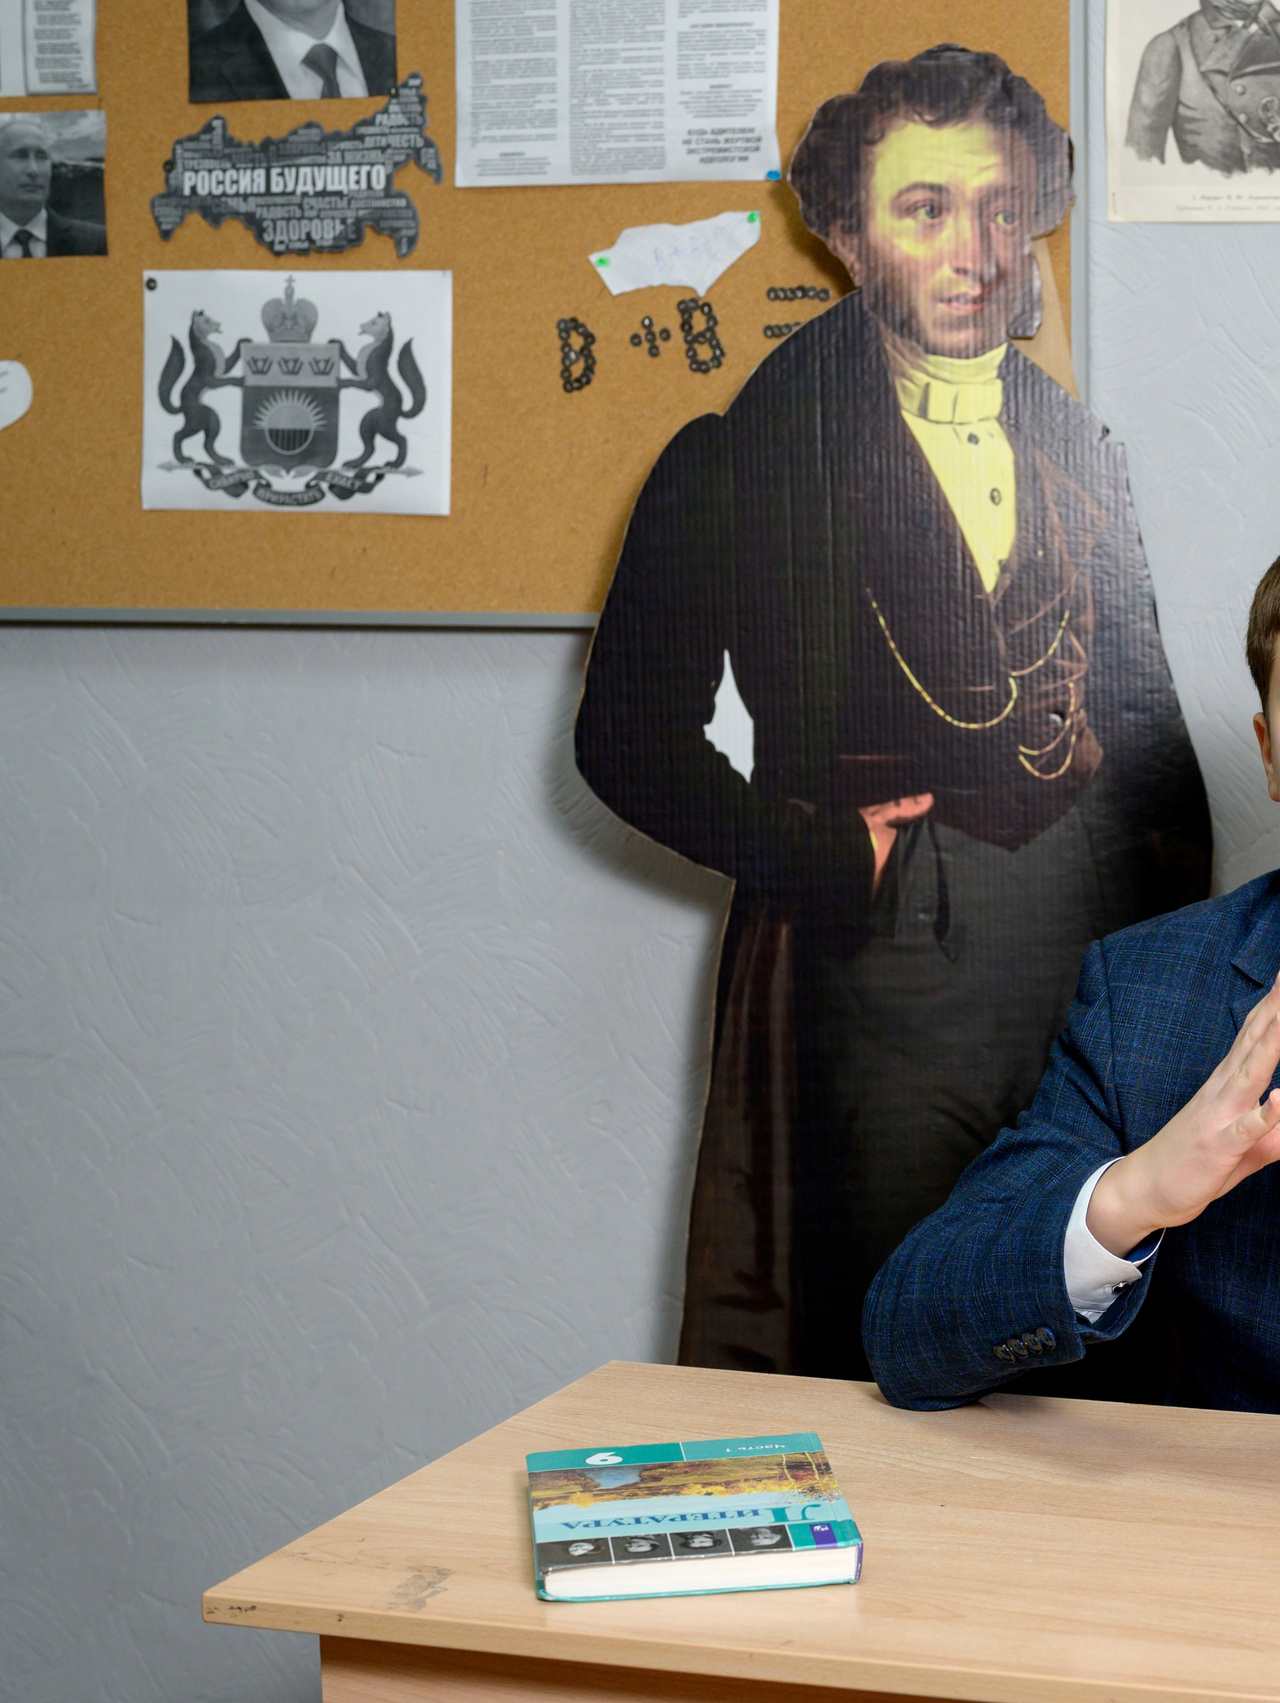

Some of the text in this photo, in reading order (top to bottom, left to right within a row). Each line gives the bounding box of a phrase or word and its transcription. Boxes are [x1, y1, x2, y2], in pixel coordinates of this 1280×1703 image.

[183, 163, 387, 197] РОССИЯ БУДУЩЕГО
[262, 218, 357, 245] ЗДОРОВЬЕ
[585, 1451, 624, 1466] 9
[561, 1503, 822, 1531] ЛИТЕРАТУРА
